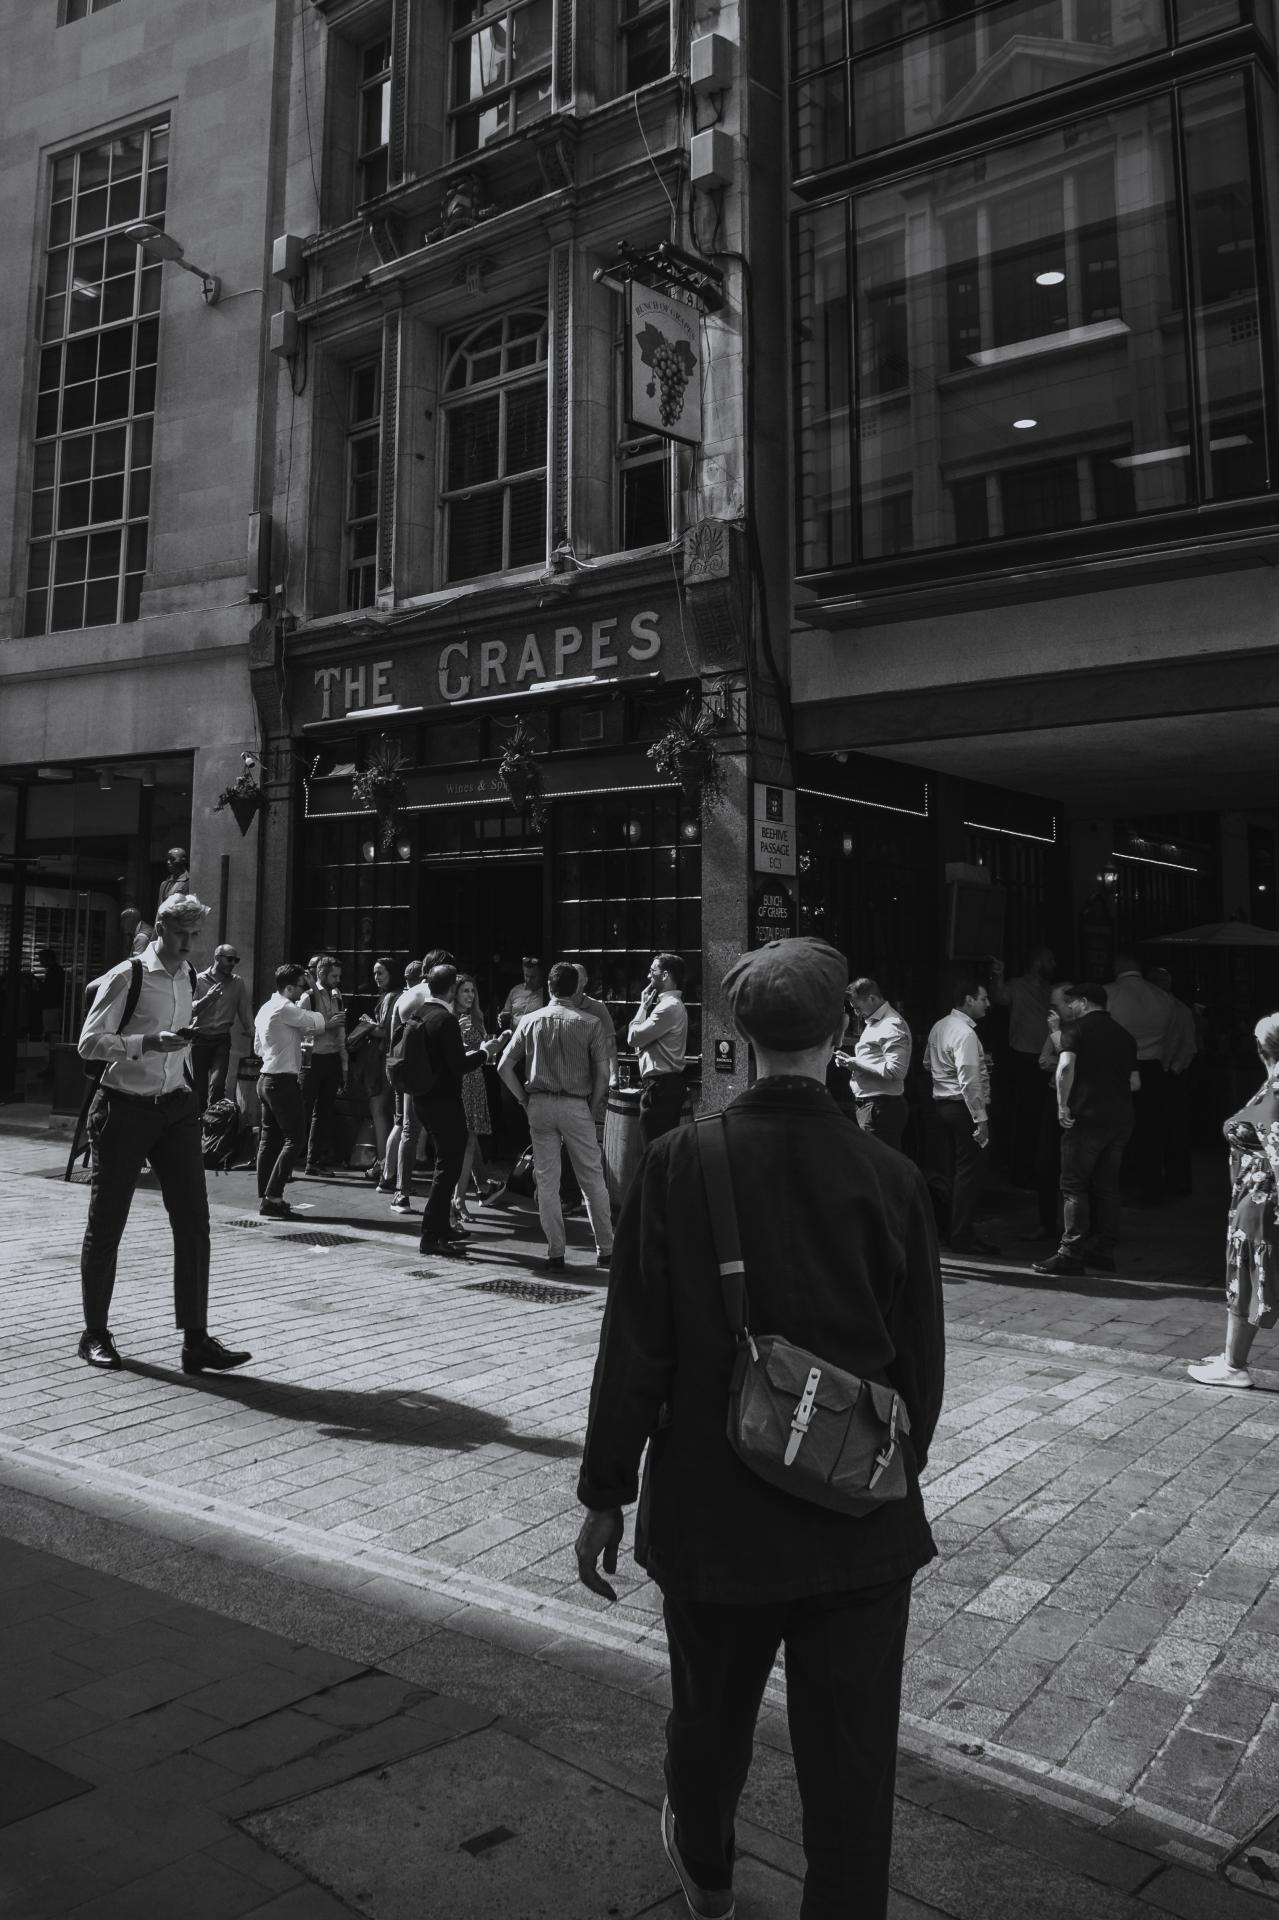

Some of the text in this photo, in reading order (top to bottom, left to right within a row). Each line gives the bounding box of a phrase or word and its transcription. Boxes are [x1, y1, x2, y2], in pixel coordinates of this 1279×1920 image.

[314, 610, 662, 720] THE GRAPES
[446, 783, 474, 795] Wines
[478, 780, 487, 792] &
[762, 827, 788, 842] BEEHIVE
[760, 841, 790, 857] PASSAGE
[769, 857, 782, 869] EC3
[763, 895, 783, 907] BUNCH
[758, 906, 788, 919] OF GRAPES
